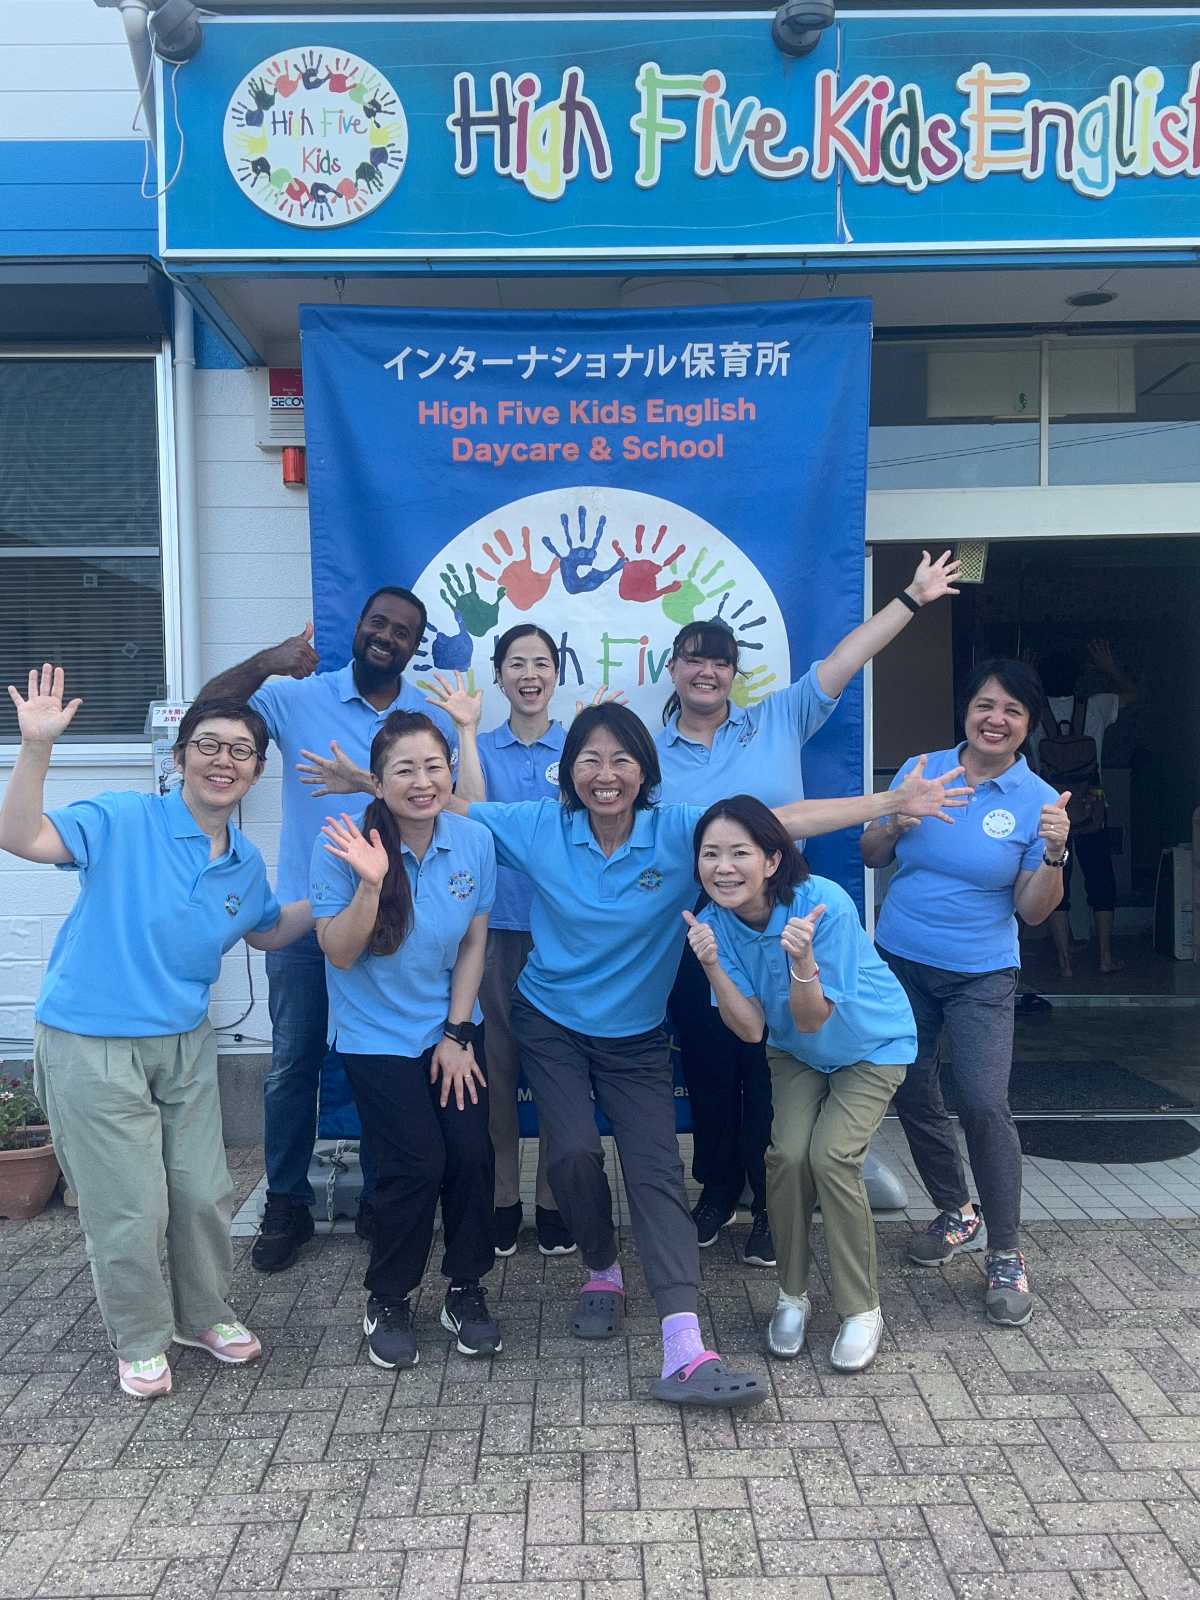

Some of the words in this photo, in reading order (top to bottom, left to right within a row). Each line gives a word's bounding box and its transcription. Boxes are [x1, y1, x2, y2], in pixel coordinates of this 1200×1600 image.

[320, 106, 368, 138] Five
[449, 68, 610, 196] High
[633, 63, 806, 185] Five
[814, 70, 962, 190] Kids
[302, 146, 341, 175] Kids
[383, 340, 791, 381] インターナショナル保育所
[417, 400, 488, 429] High
[497, 400, 561, 425] Five
[569, 399, 637, 425] Kids
[646, 397, 756, 427] English
[451, 437, 580, 466] Daycare
[589, 436, 613, 461] &
[623, 433, 724, 461] School
[596, 631, 672, 689] Fiv
